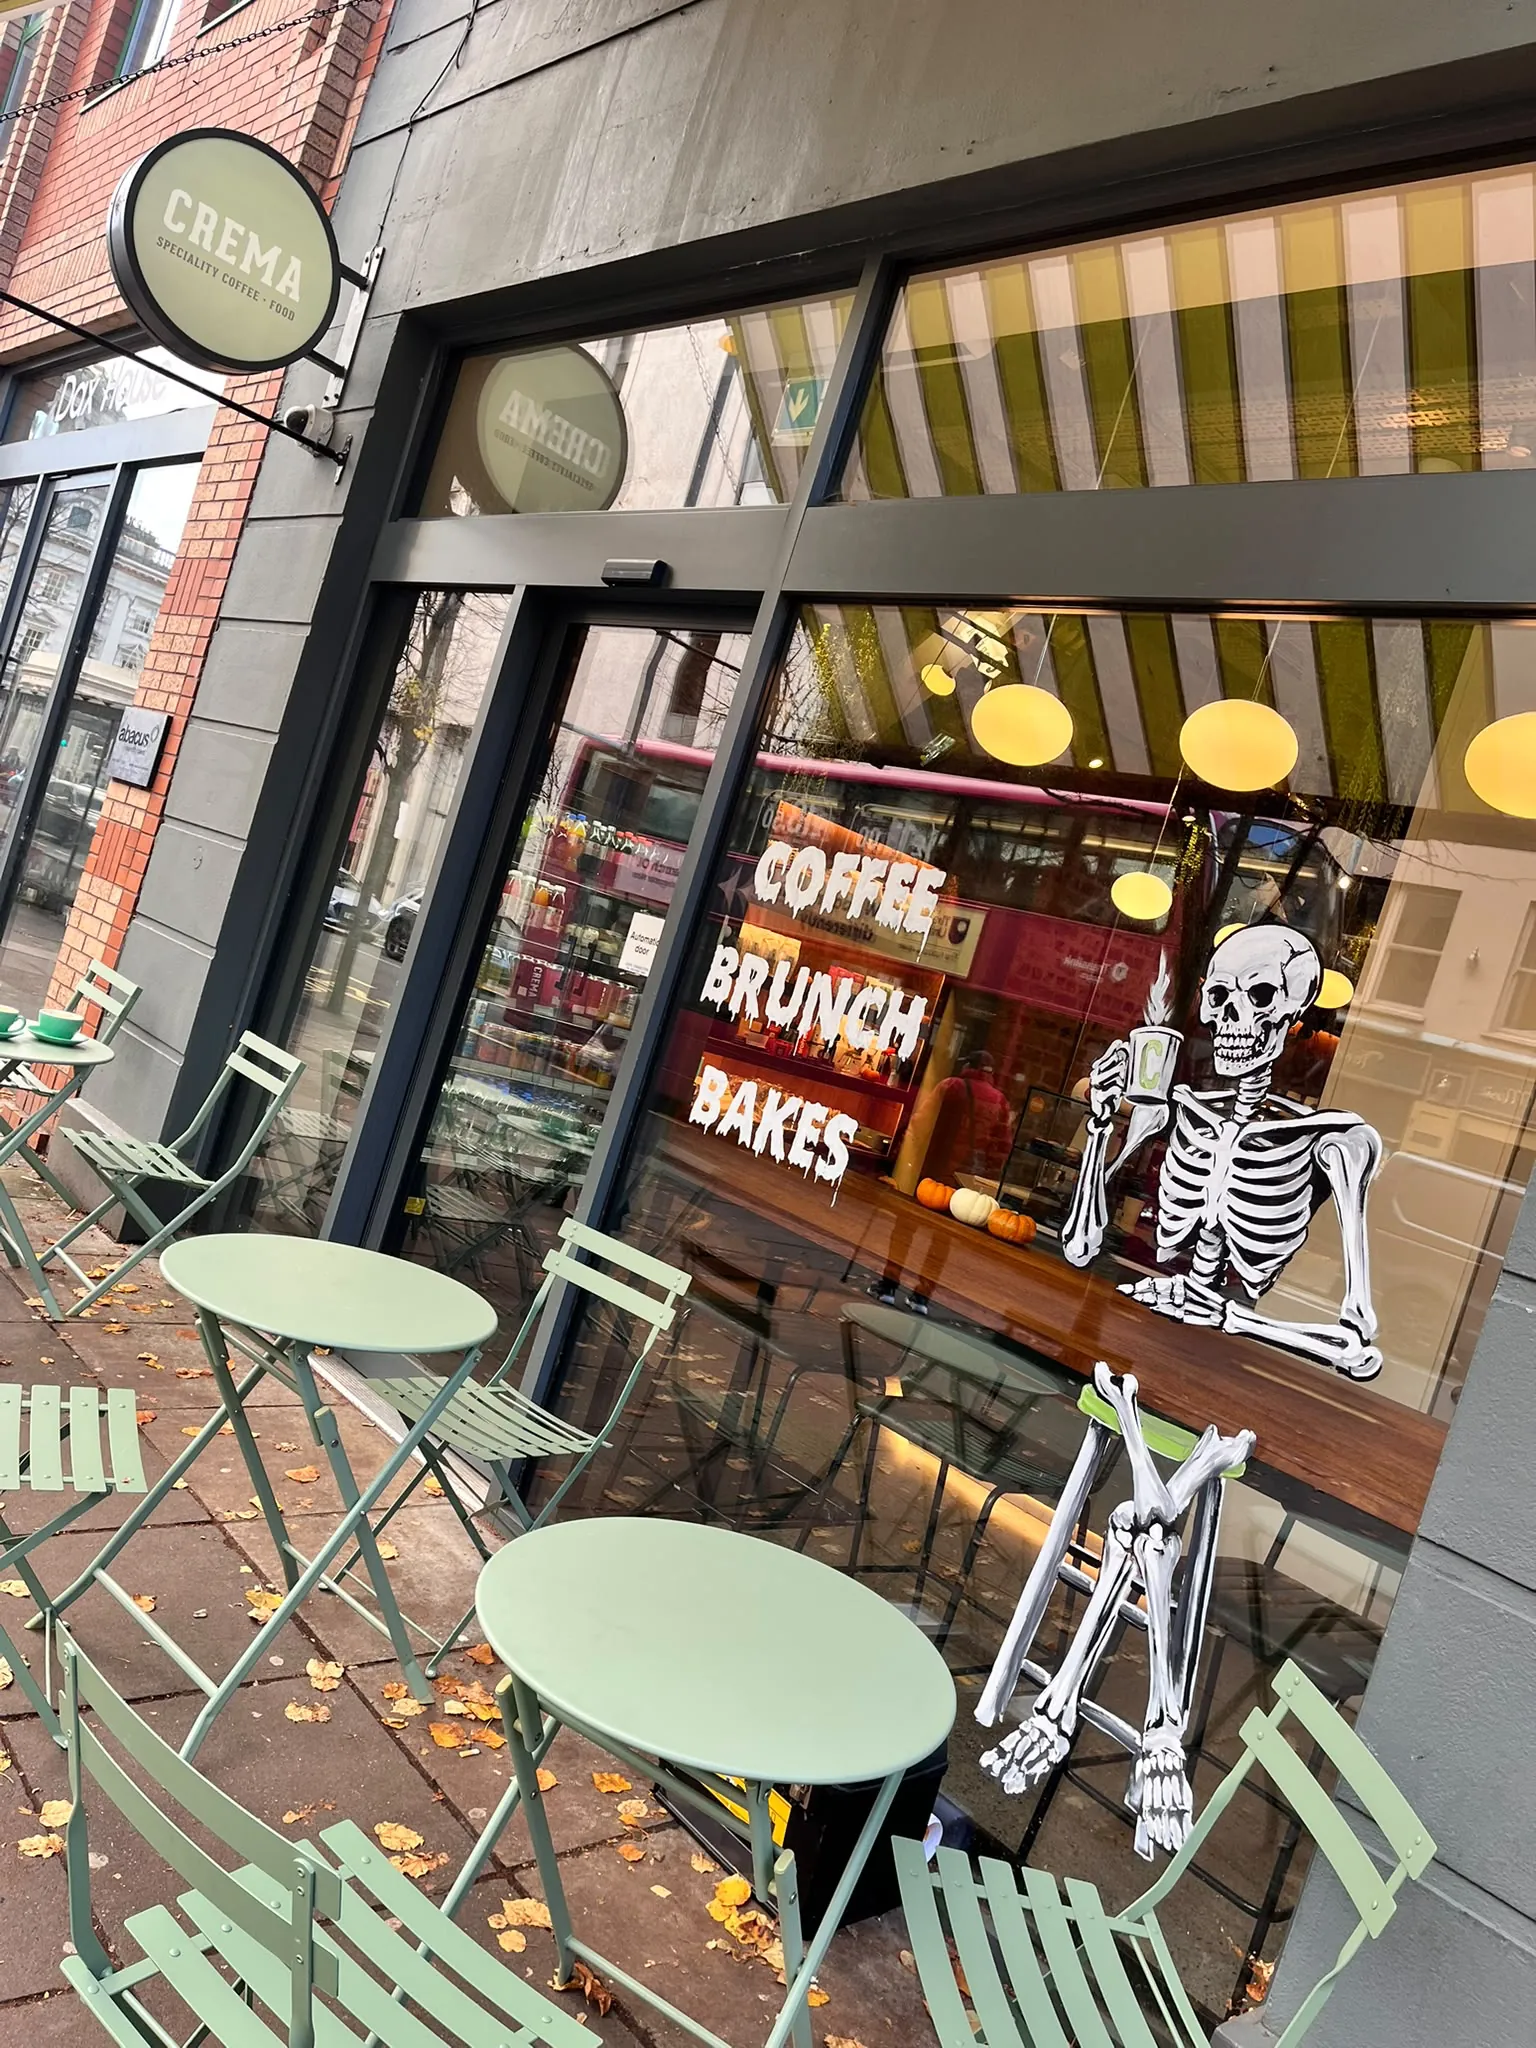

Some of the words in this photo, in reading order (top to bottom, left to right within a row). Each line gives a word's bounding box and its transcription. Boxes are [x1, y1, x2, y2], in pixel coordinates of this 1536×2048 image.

[156, 236, 219, 278] SPECIALITY
[221, 272, 260, 302] COFFEE
[269, 299, 296, 322] FOOD
[163, 188, 303, 303] CREMA
[54, 374, 101, 422] Dax
[119, 725, 150, 747] abacus
[754, 841, 947, 963] COFFEE
[527, 966, 543, 998] CREMA
[634, 944, 650, 956] door
[700, 944, 929, 1063] BRUNCH
[1139, 1039, 1164, 1090] C
[688, 1063, 860, 1207] BAKES
